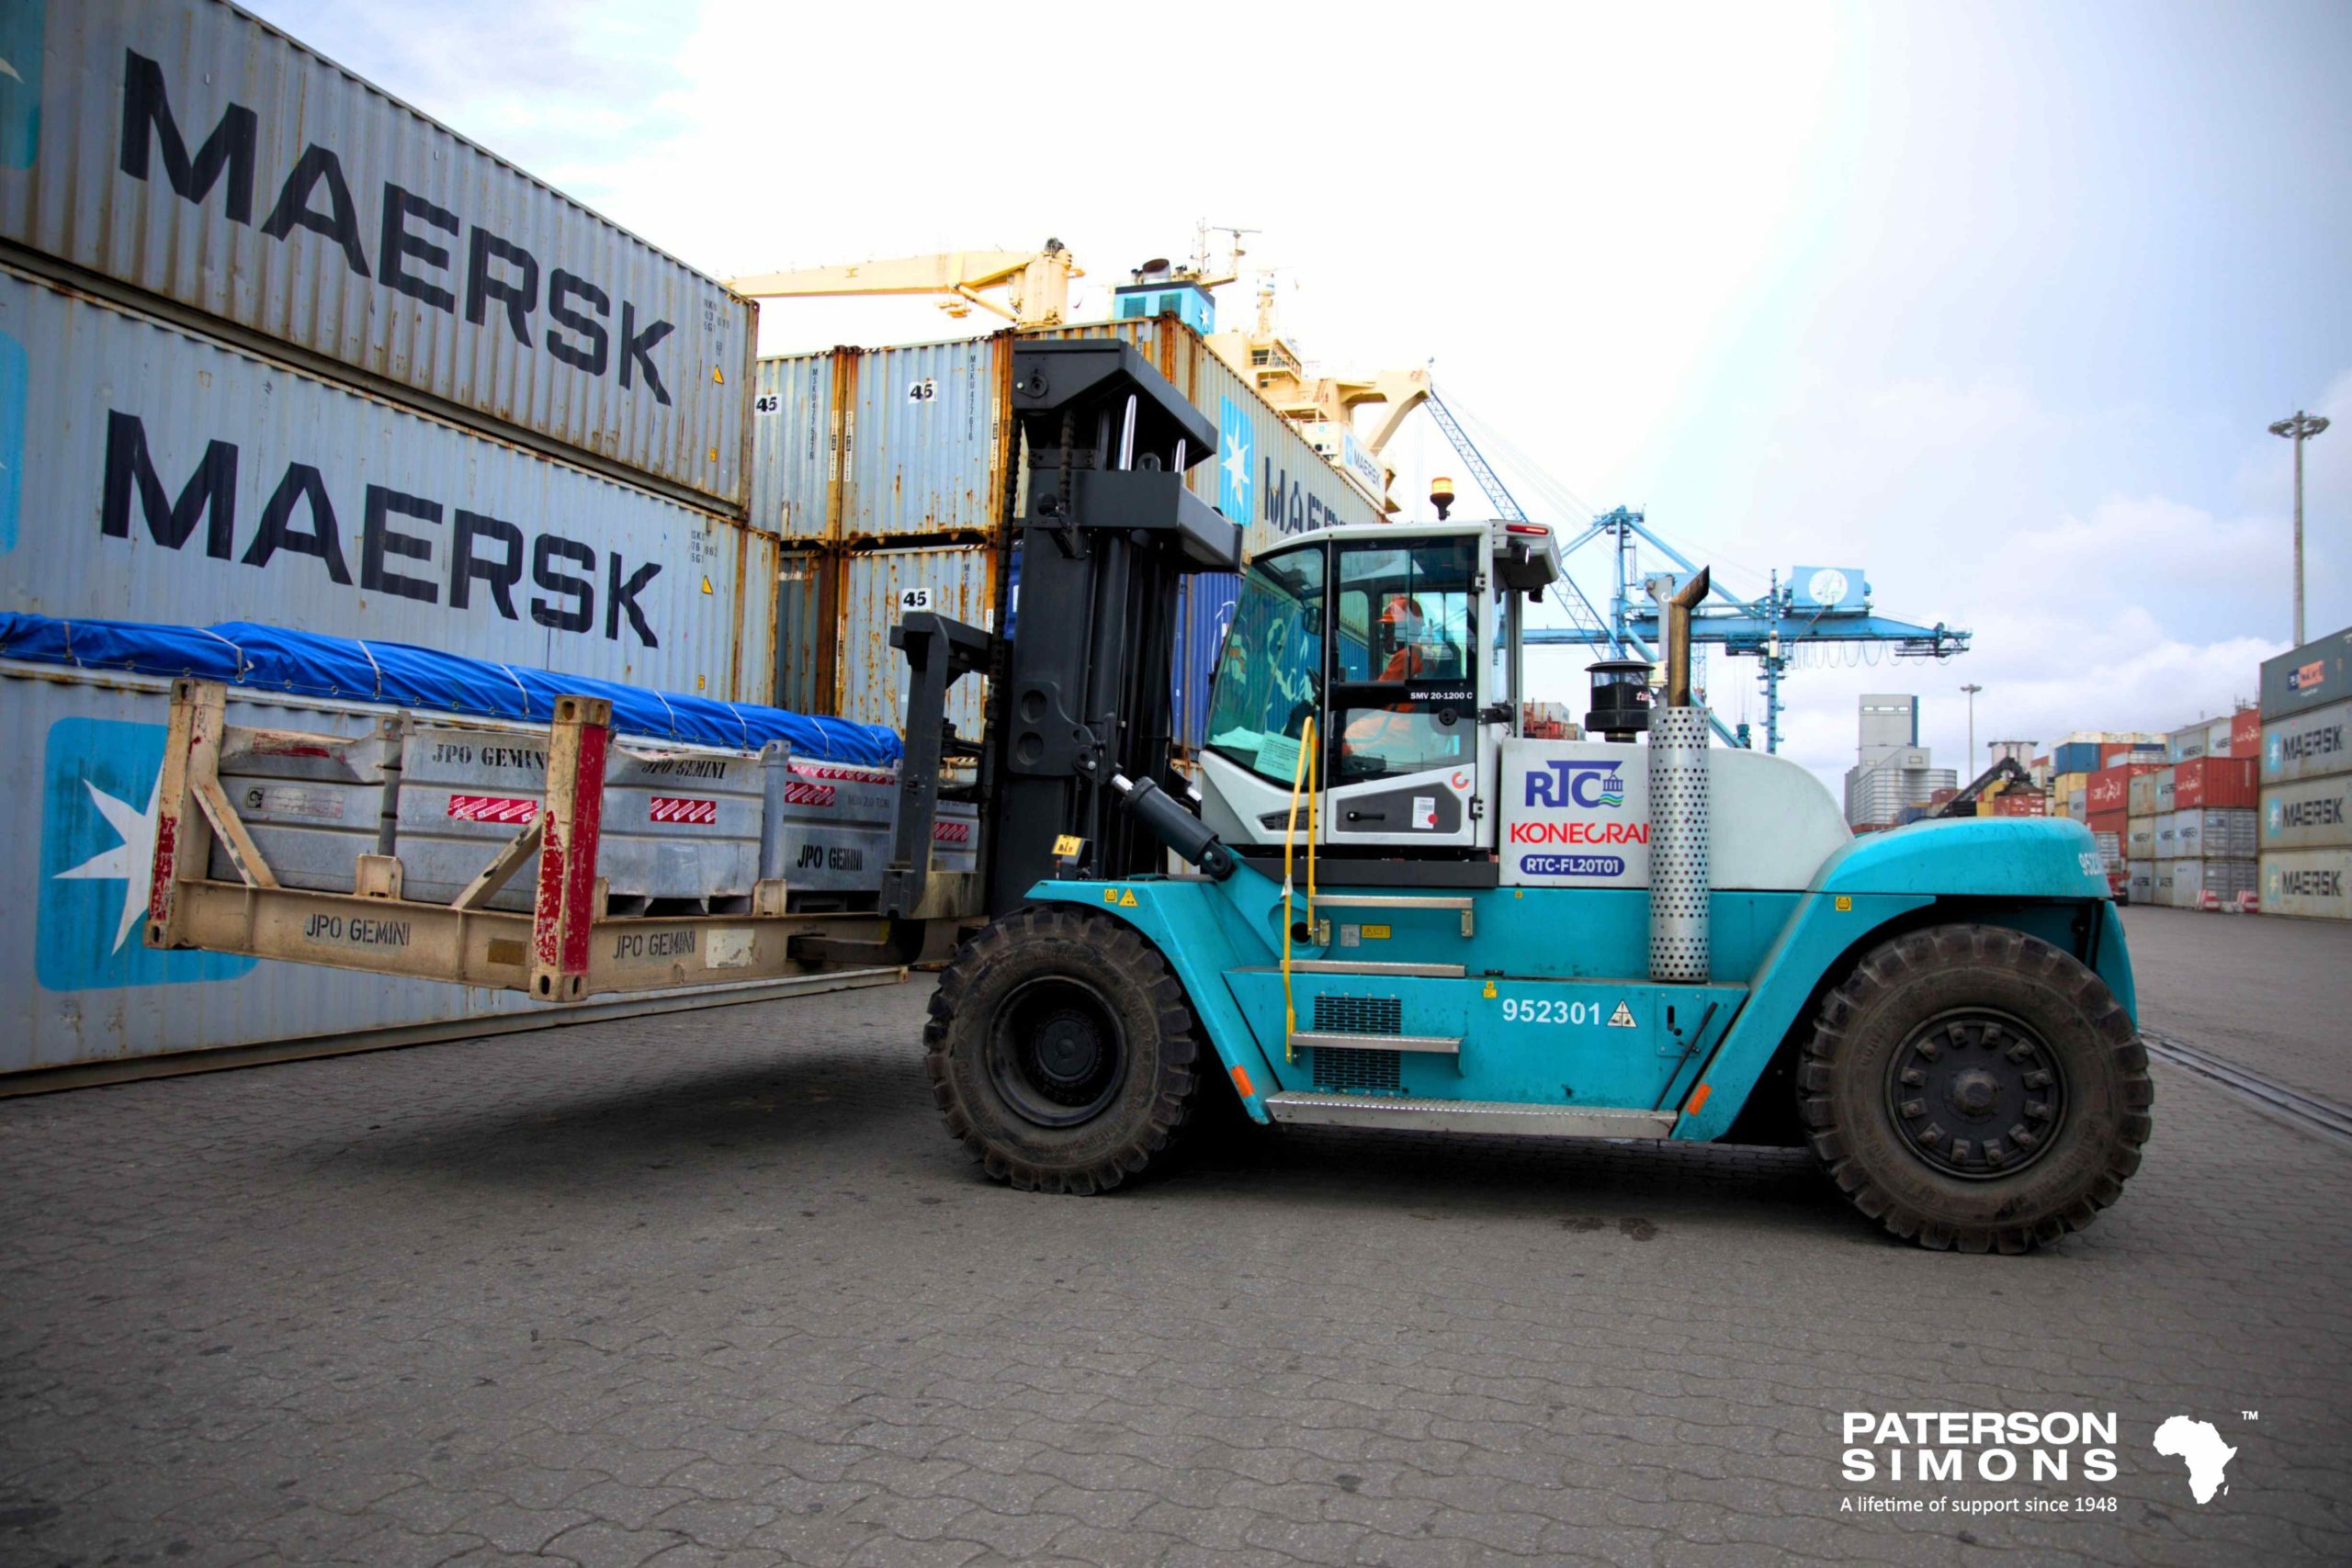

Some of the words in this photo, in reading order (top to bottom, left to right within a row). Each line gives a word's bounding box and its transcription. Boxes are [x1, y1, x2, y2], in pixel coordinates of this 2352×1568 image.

[119, 47, 676, 407] MAERSK
[755, 396, 778, 412] 45
[910, 383, 933, 400] 45
[101, 409, 662, 649] MAERSK
[903, 591, 927, 607] 45
[1410, 692, 1429, 700] SMV
[1430, 692, 1464, 700] 20-1200
[1466, 692, 1474, 700] C
[432, 743, 472, 764] JPO
[481, 747, 548, 770] GEMIN
[2282, 724, 2343, 762] MAERSK
[1525, 761, 1623, 808] RTC
[2282, 797, 2344, 828] MAERSK
[797, 844, 823, 869] JPO
[829, 846, 863, 872] GEMINI
[1526, 858, 1619, 874] RTC-FL20T01
[2282, 870, 2343, 897] MAERSK
[306, 913, 342, 939] JPO
[350, 918, 412, 947] GEMINI
[612, 934, 643, 959] JPO
[649, 930, 695, 956] GEMINI
[1502, 998, 1600, 1026] 952301
